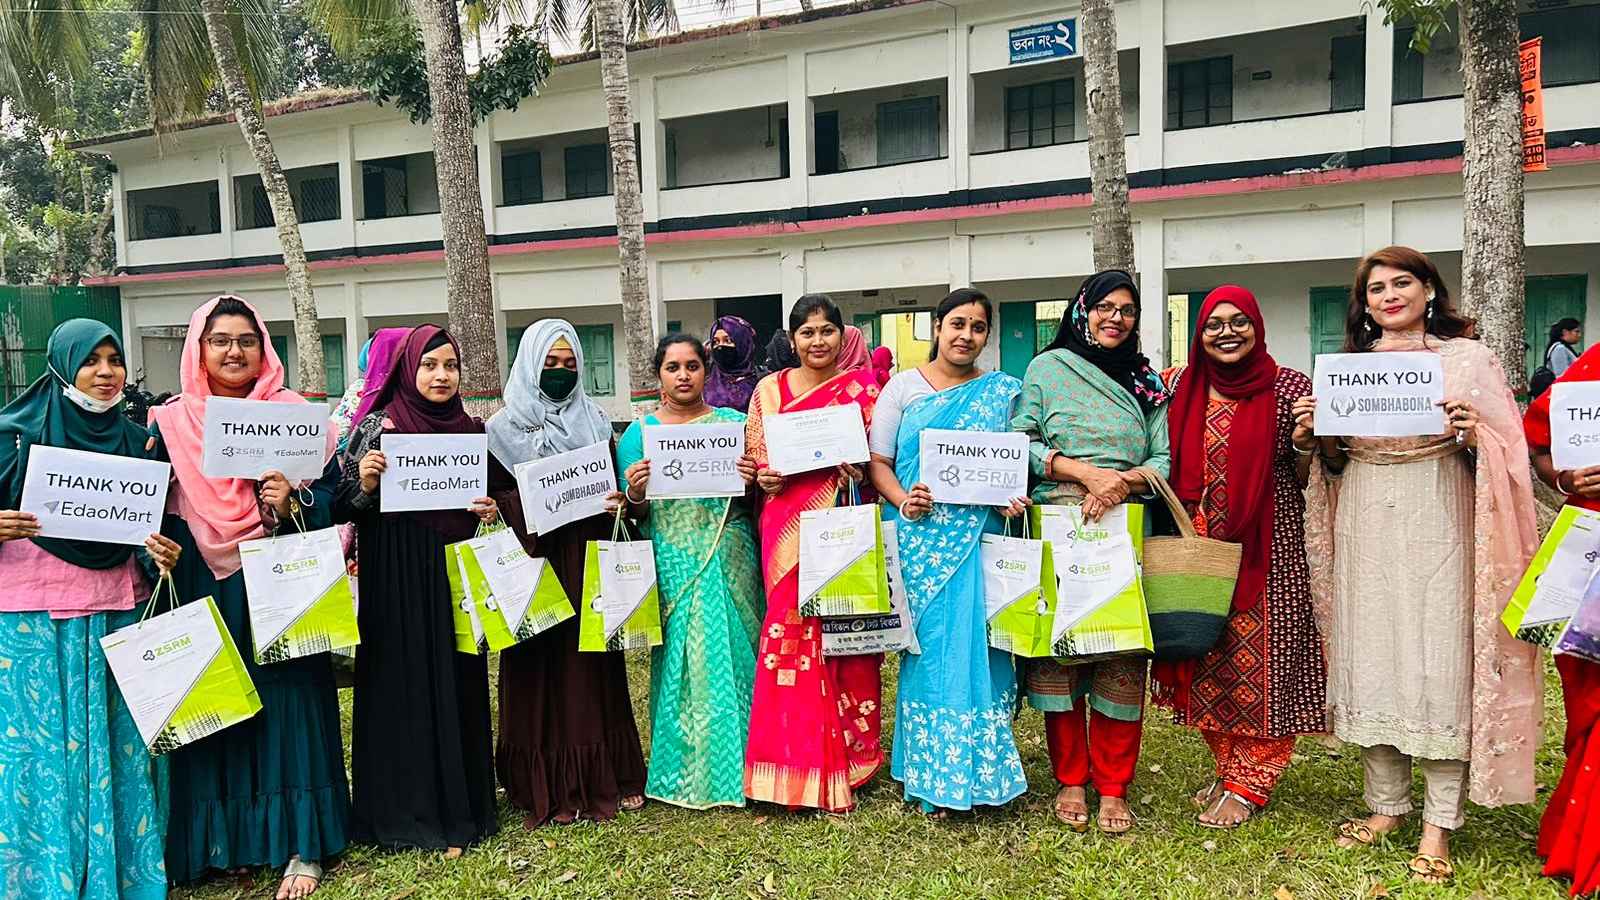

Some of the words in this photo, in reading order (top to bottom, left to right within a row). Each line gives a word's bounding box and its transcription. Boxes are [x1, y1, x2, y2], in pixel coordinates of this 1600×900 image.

[1011, 37, 1036, 51] ভবন
[1327, 372, 1389, 386] THANK
[1393, 371, 1433, 385] YOU
[1357, 397, 1433, 412] SOMBHABONA
[221, 422, 281, 436] THANK
[286, 424, 320, 436] YOU
[657, 438, 706, 451] THANK
[708, 437, 737, 449] YOU
[936, 443, 987, 458] THANK
[991, 447, 1021, 460] YOU
[280, 449, 319, 457] EdaoMart
[396, 455, 448, 467] THANK
[451, 454, 480, 466] YOU
[538, 466, 580, 489] THANK
[581, 459, 607, 475] YOU
[686, 460, 736, 473] ZSRM
[46, 472, 114, 493] THANK
[119, 480, 158, 497] YOU
[411, 477, 480, 491] EdaoMart
[964, 469, 1018, 485] ZSRM
[561, 479, 611, 504] SOMBHABONA
[60, 501, 153, 523] EdaoMart
